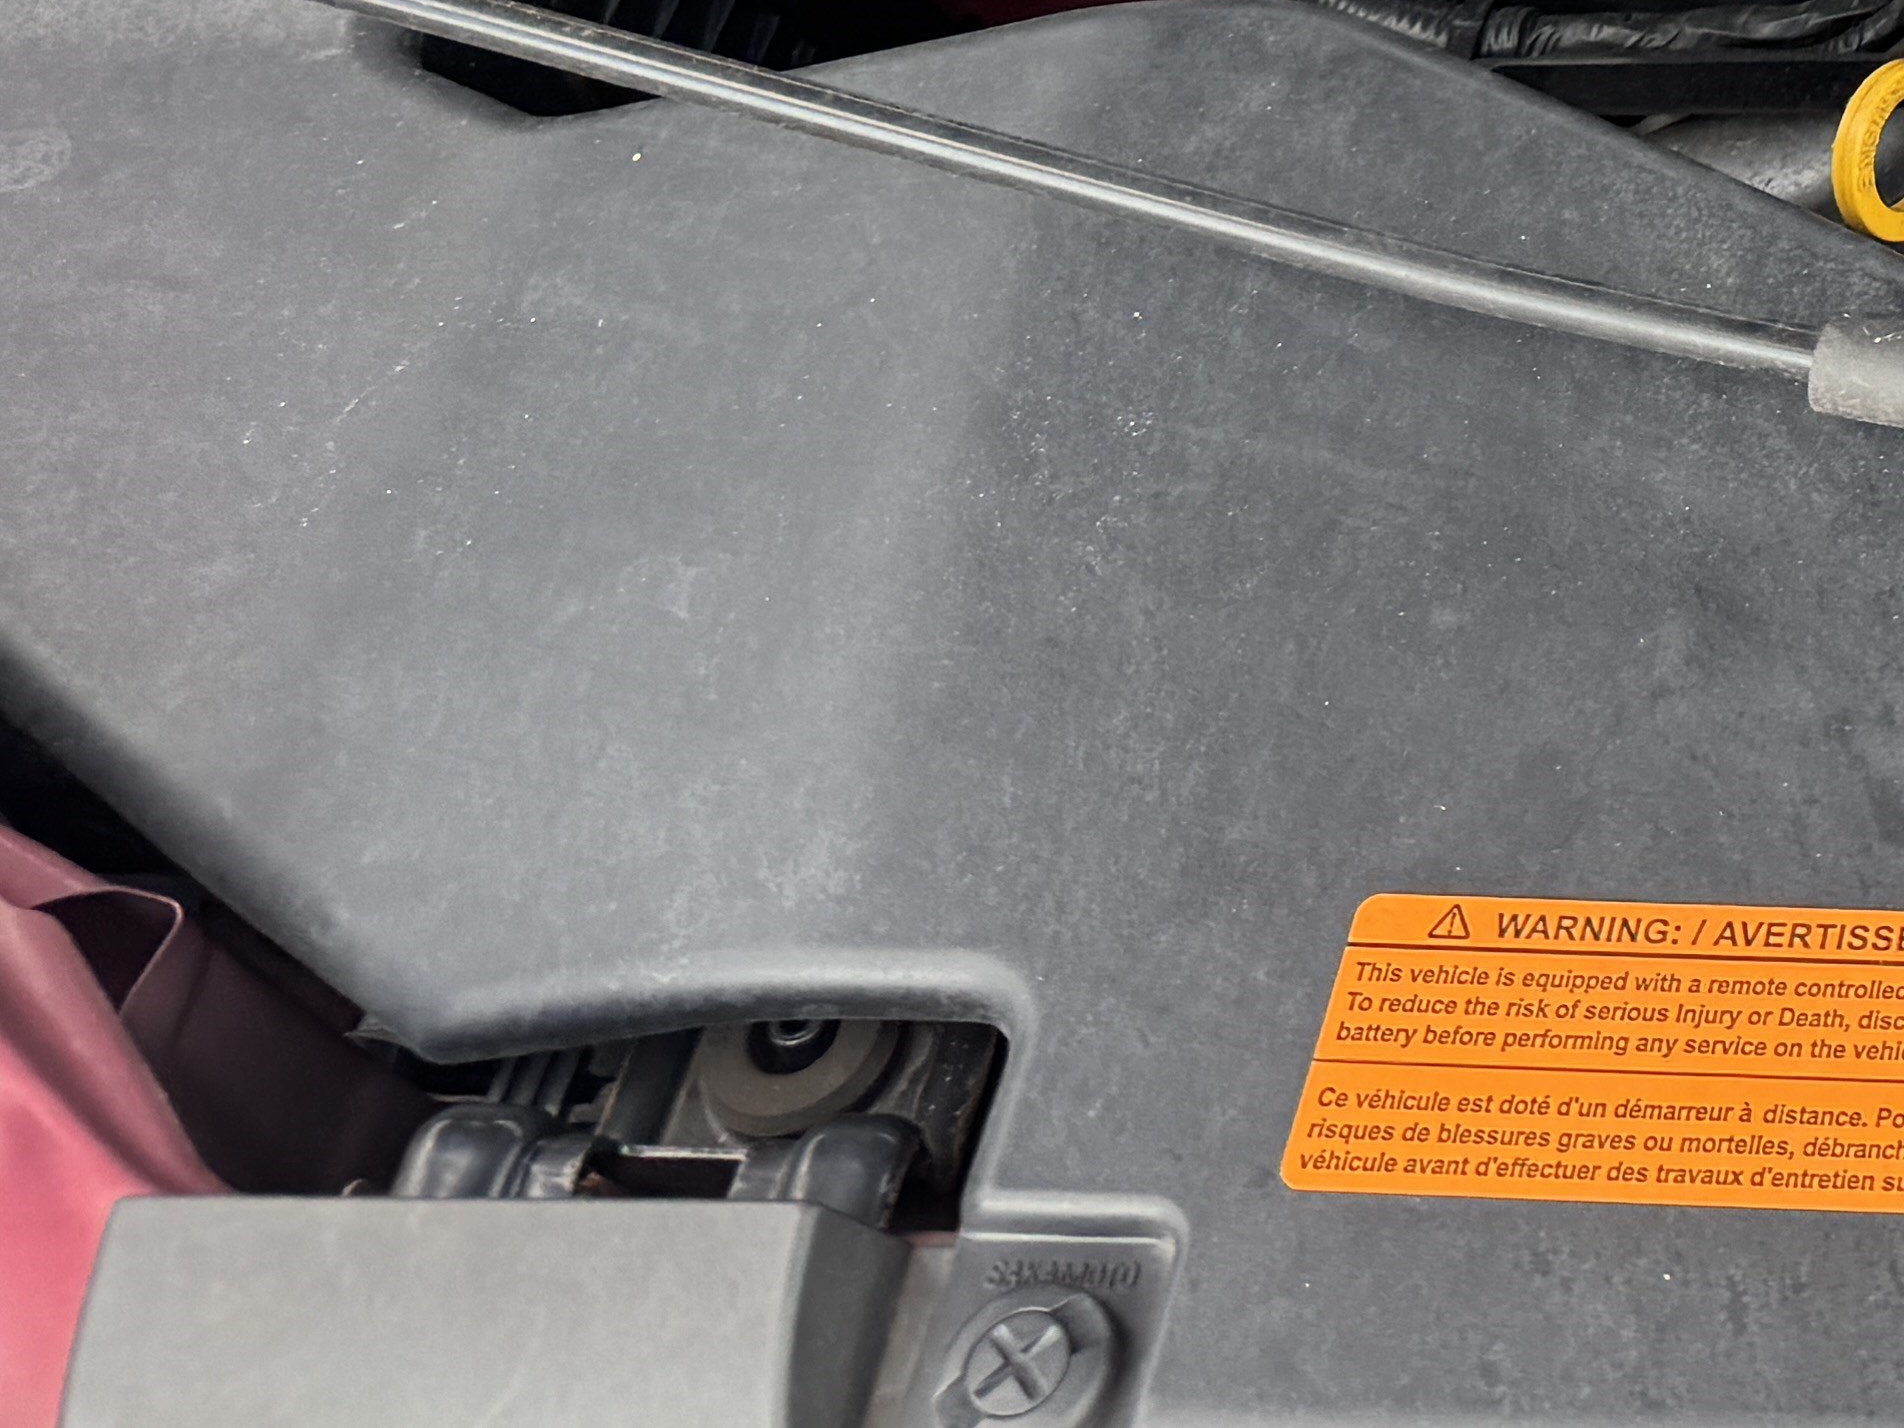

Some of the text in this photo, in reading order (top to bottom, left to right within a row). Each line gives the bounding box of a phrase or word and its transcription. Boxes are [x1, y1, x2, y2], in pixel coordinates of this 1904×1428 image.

[1497, 912, 1682, 945] WARNING:
[1355, 961, 1402, 983] This
[1410, 963, 1489, 986] vehicle
[1496, 966, 1515, 988] is
[1521, 970, 1628, 994] equipped
[1634, 971, 1682, 993] with
[1688, 977, 1701, 994] a
[1708, 978, 1787, 997] remote
[1347, 992, 1373, 1012] To
[1378, 993, 1457, 1015] reduce
[1464, 995, 1499, 1016] the
[1505, 996, 1549, 1018] risk
[1555, 998, 1581, 1020] of
[1584, 1001, 1670, 1023] serious
[1675, 1003, 1741, 1028] Injury
[1748, 1011, 1774, 1027] or
[1777, 1008, 1850, 1032] Death,
[1337, 1021, 1418, 1048] battery
[1423, 1024, 1497, 1047] before
[1501, 1026, 1629, 1055] performing
[1636, 1035, 1677, 1058] any
[1684, 1034, 1766, 1056] service
[1773, 1041, 1801, 1057] on
[1810, 1039, 1846, 1059] the
[1317, 1086, 1349, 1108] Ce
[1356, 1088, 1451, 1113] véhicule
[1456, 1094, 1494, 1114] est
[1499, 1094, 1551, 1116] doté
[1557, 1096, 1607, 1119] d'un
[1614, 1098, 1734, 1123] démarreur
[1739, 1101, 1751, 1123] à
[1763, 1105, 1868, 1128] distance.
[1307, 1118, 1394, 1144] risques
[1401, 1121, 1430, 1143] de
[1437, 1123, 1551, 1148] blessures
[1555, 1129, 1636, 1153] graves
[1643, 1135, 1673, 1152] ou
[1680, 1135, 1795, 1160] mortelles,
[1300, 1149, 1398, 1173] véhicule
[1402, 1156, 1468, 1176] avant
[1475, 1156, 1603, 1181] d'effectuer
[1606, 1160, 1648, 1182] des
[1655, 1165, 1744, 1186] travaux
[1750, 1166, 1876, 1191] d'entretien
